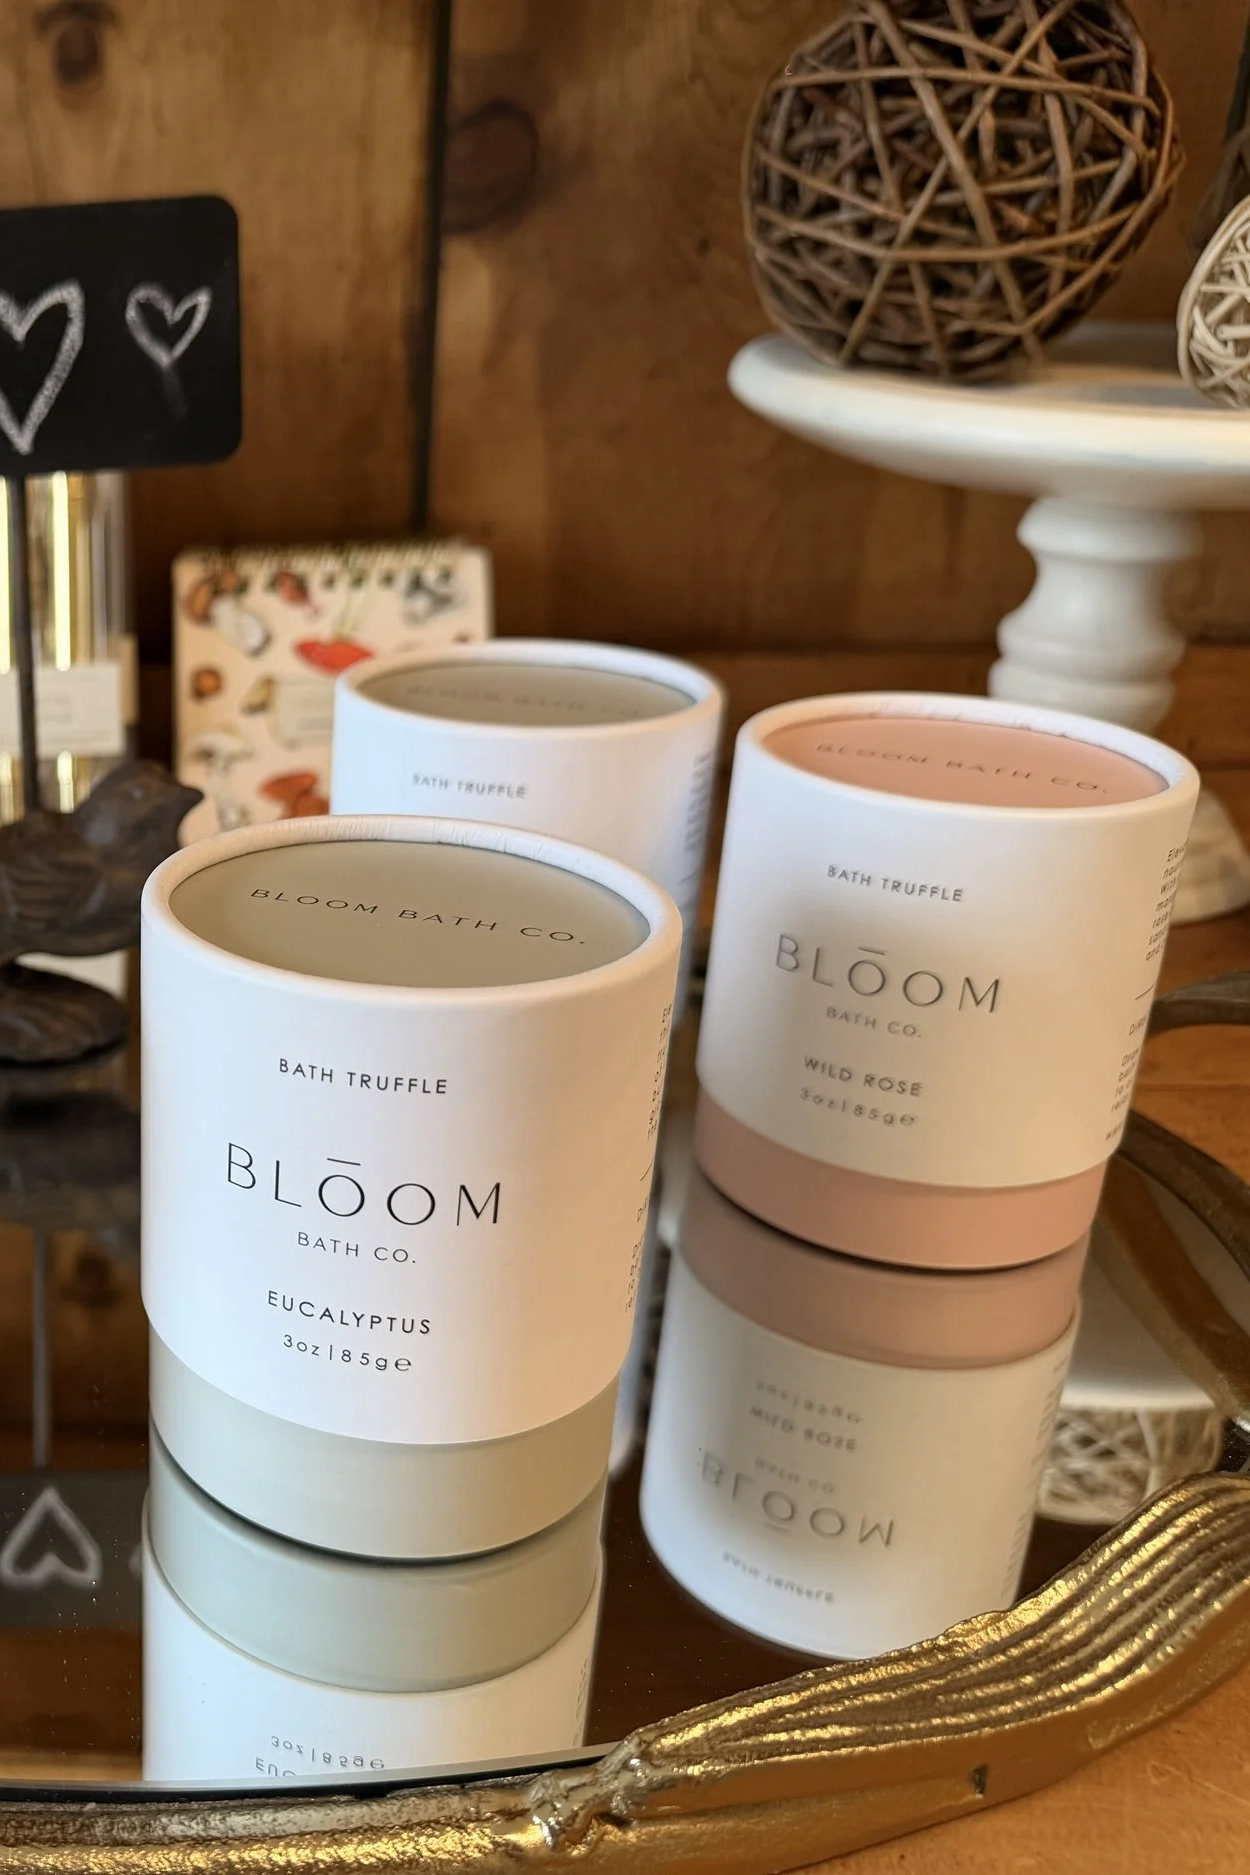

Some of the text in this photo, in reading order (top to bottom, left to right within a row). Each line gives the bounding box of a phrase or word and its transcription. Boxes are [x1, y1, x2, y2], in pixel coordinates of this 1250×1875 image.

[815, 742, 928, 765] BLOOM
[945, 758, 1033, 780] BATH
[412, 773, 529, 799] BATH TRUFFLE
[827, 864, 963, 903] BATH TRUFFLE
[251, 887, 588, 945] BLOOM BATH CO.
[826, 1005, 924, 1038] BATH CO.
[279, 1058, 449, 1095] BATH TRUFFLE
[804, 1054, 924, 1097] WILD ROSE
[297, 1231, 418, 1265] BATH CO.
[267, 1289, 433, 1336] EUCALYPTUS
